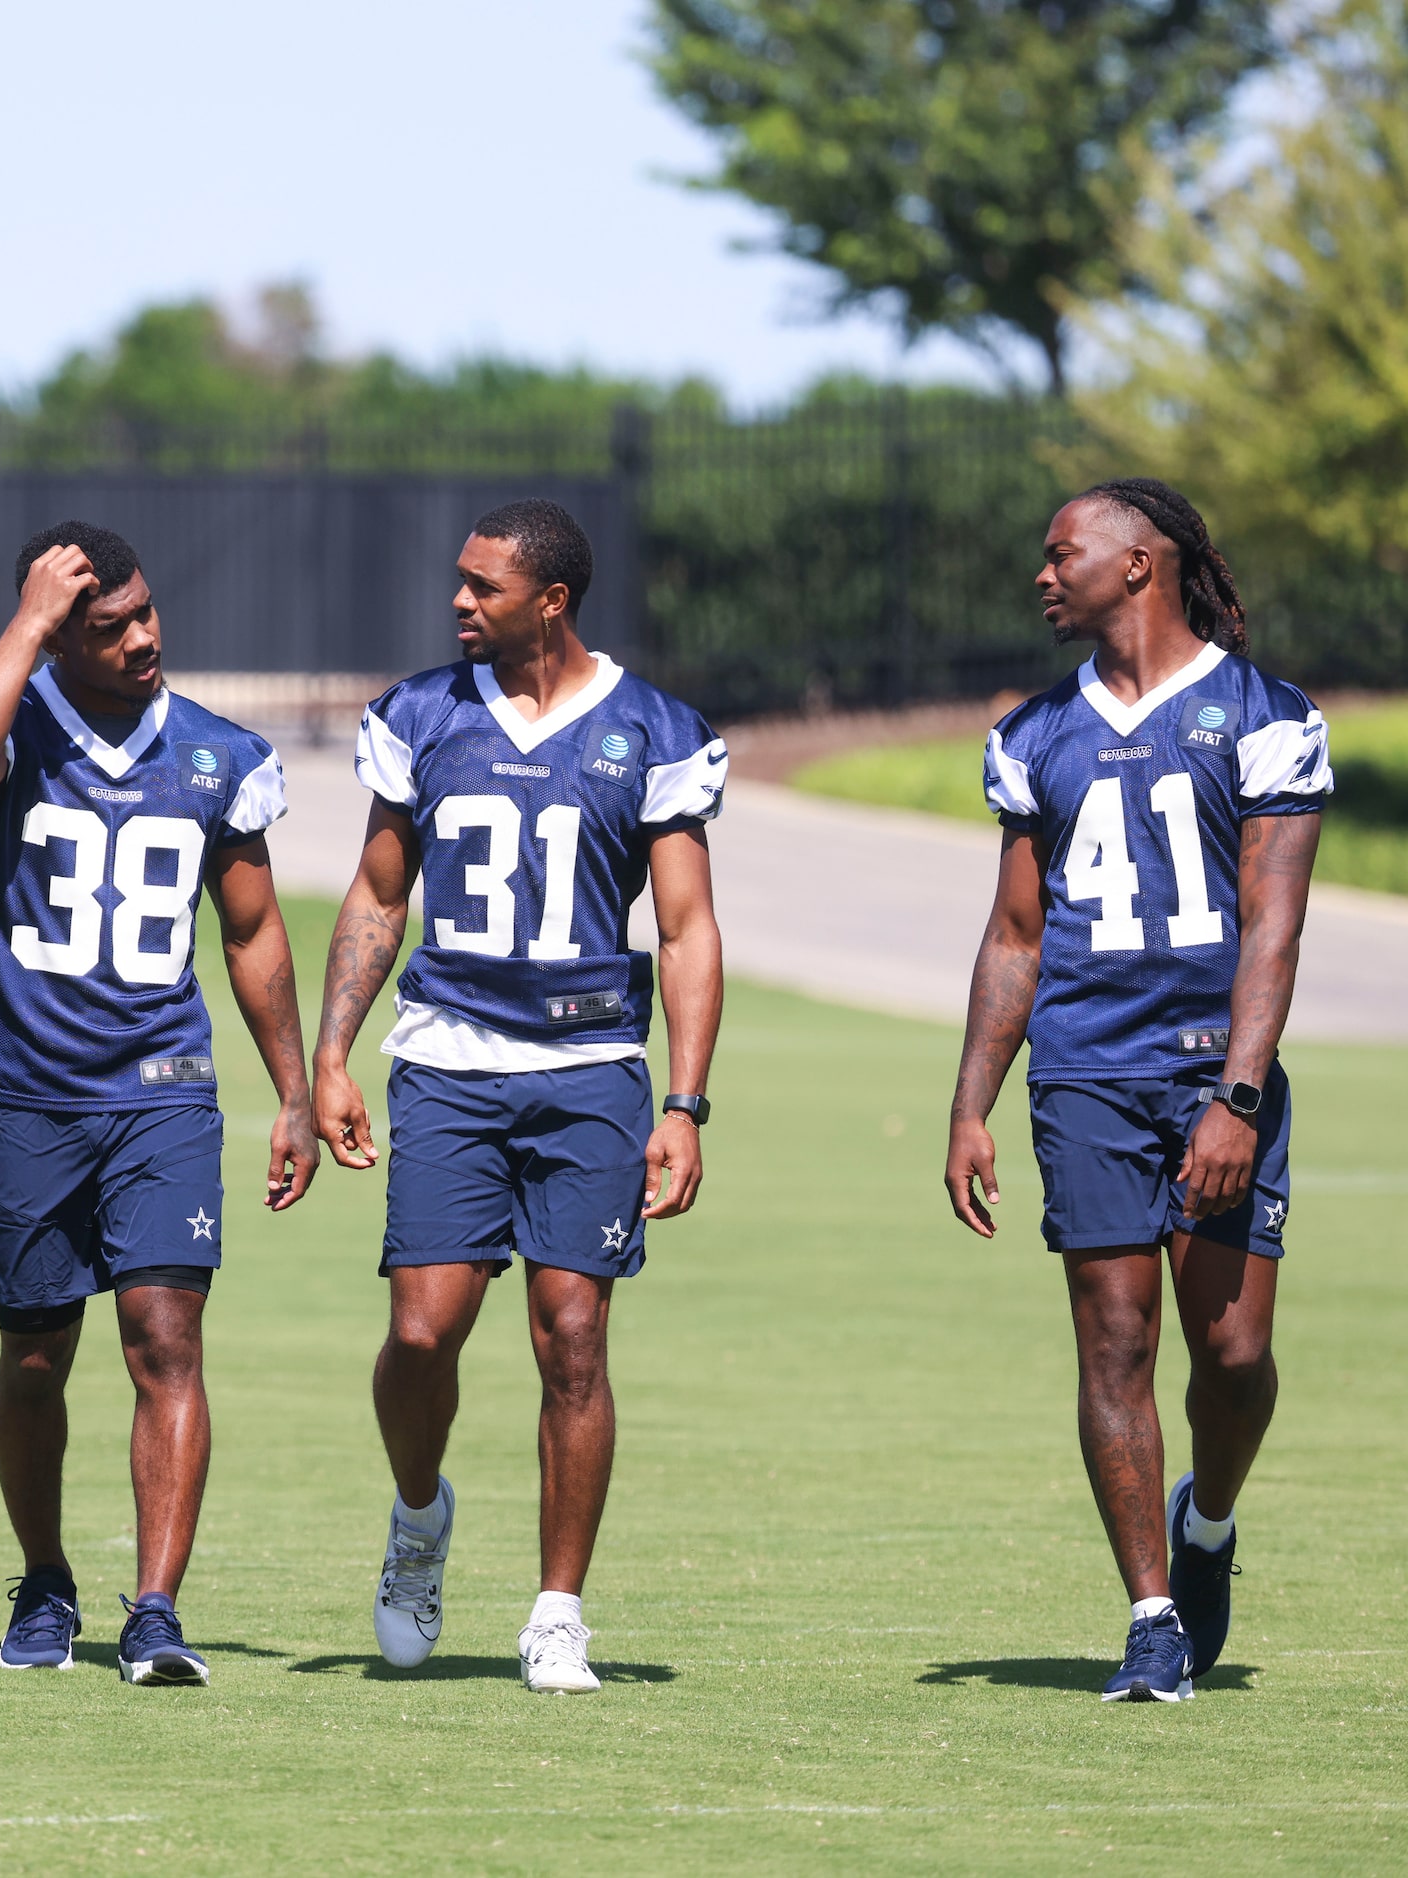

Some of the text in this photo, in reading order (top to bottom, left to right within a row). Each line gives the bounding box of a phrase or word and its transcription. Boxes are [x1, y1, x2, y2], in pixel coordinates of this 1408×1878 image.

[1187, 728, 1224, 747] AT&T
[1098, 746, 1153, 761] COWBOYS
[492, 762, 550, 777] COWBOYS
[592, 759, 627, 778] AT&T
[191, 774, 221, 790] AT&T
[88, 787, 143, 802] COWBOYS
[1063, 772, 1224, 952] 41
[434, 794, 581, 960] 31
[11, 801, 206, 985] 38
